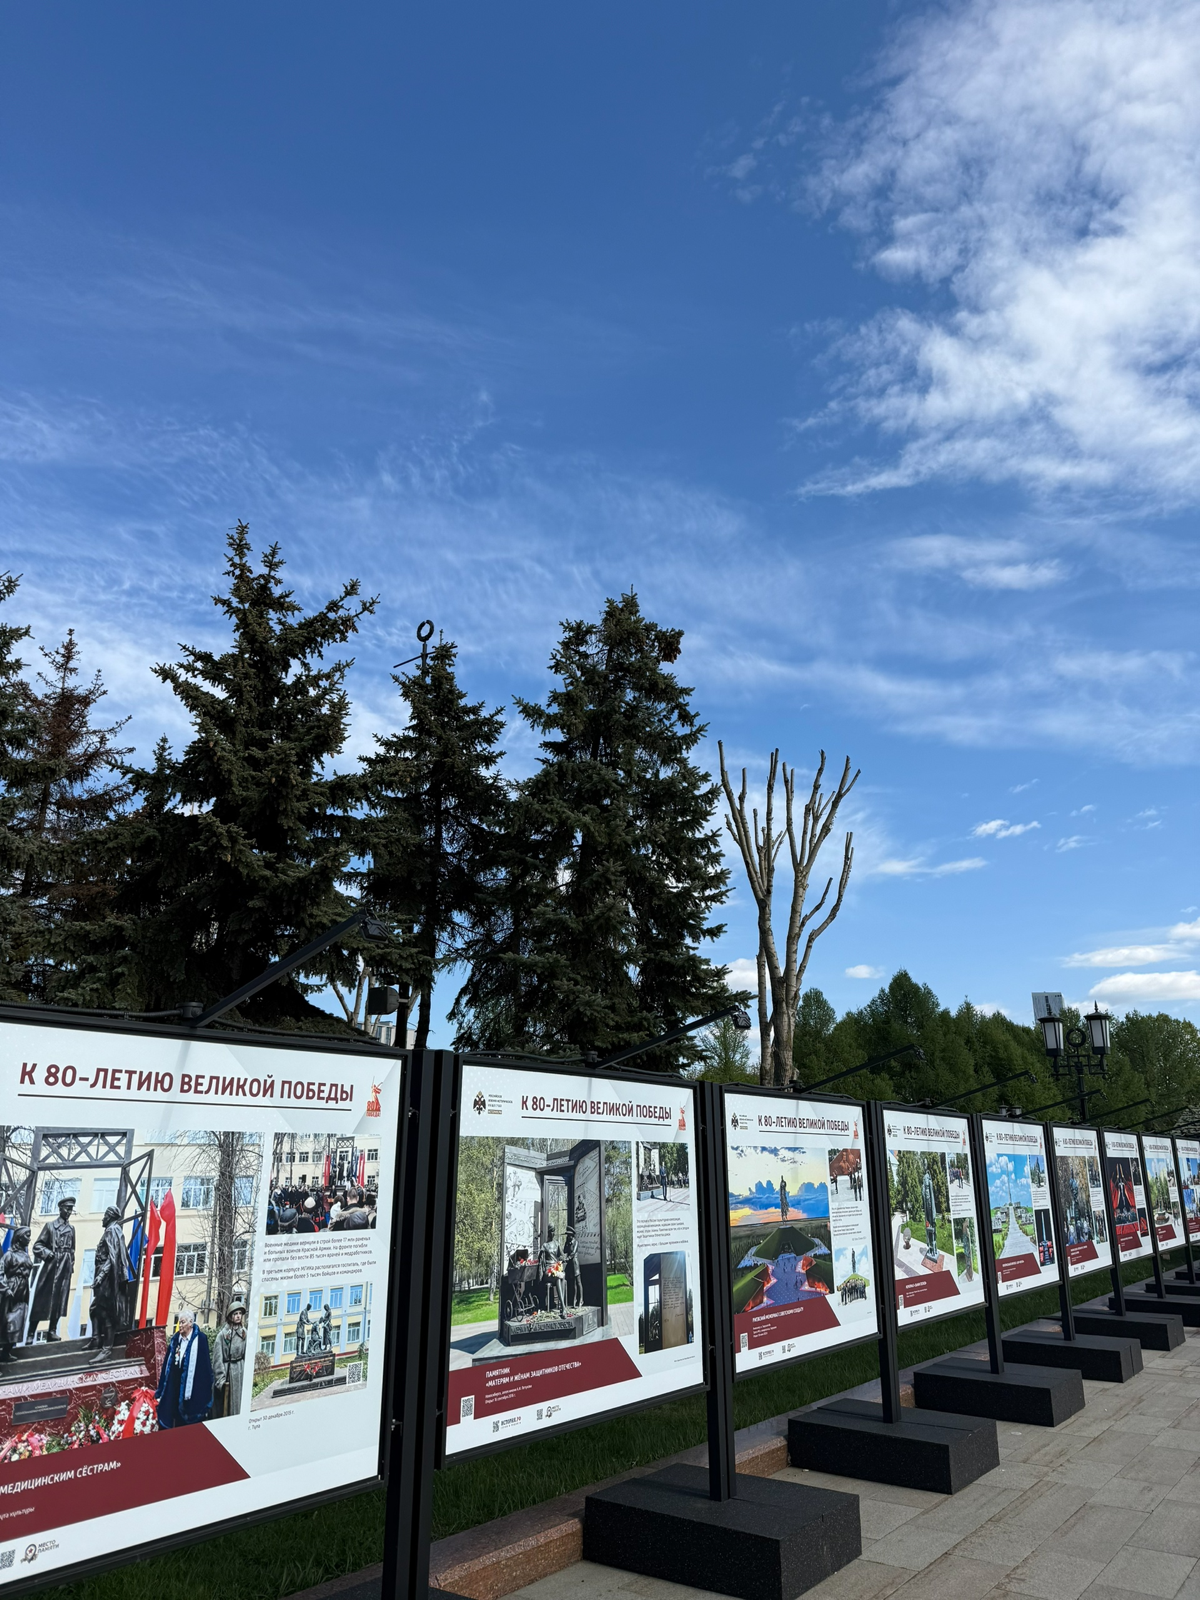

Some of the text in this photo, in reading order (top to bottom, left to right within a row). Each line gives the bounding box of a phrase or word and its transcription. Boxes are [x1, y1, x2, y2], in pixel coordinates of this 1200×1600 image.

[20, 1062, 354, 1104] К 80-ЛЕТИЮ ВЕЛИКОЙ ПОБЕДЫ
[522, 1096, 529, 1110] К
[532, 1096, 587, 1114] 80-ЛЕТИЮ
[590, 1100, 634, 1117] ВЕЛИКОЙ
[636, 1104, 672, 1122] ПОБЕДЫ
[758, 1115, 763, 1126] К
[764, 1115, 797, 1128] 80-ЛЕТИЮ
[798, 1117, 825, 1130] ВЕЛИКОЙ
[827, 1120, 849, 1132] ПОБЕДЫ
[486, 1367, 510, 1378] ПАМЯТНИК
[0, 1461, 121, 1495] МЕДИЦИНСКИМ СЁСТРАМ»
[37, 1544, 59, 1554] ПАМЯТИ
[38, 1540, 56, 1548] МЕСТО
